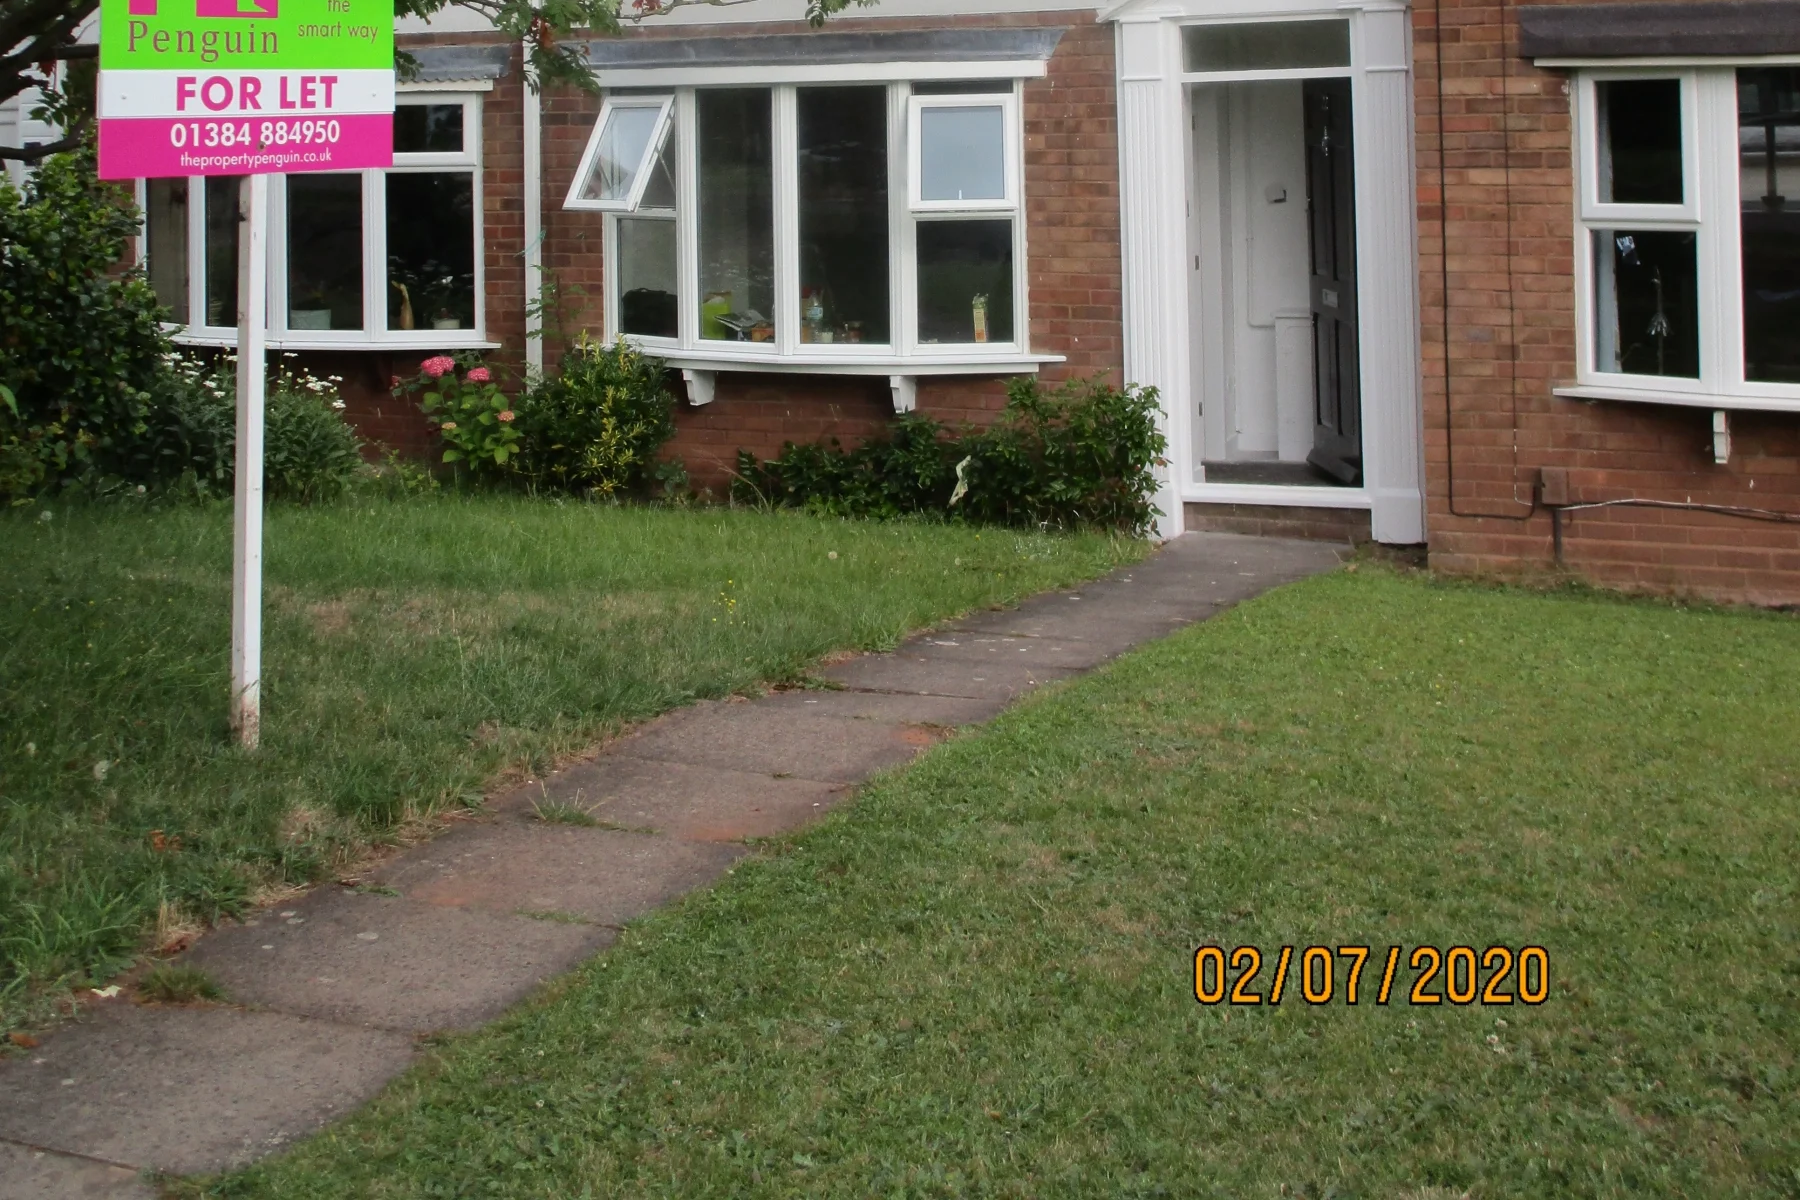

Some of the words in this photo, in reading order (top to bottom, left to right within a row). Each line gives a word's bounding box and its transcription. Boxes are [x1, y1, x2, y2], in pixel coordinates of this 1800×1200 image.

[127, 20, 279, 63] Penguin
[297, 18, 341, 38] smart
[347, 23, 378, 43] way
[176, 75, 262, 112] FOR
[279, 75, 338, 110] LET
[170, 122, 251, 148] 01384
[260, 119, 340, 145] 884950
[180, 147, 332, 170] thepropertypenguin.co.uk
